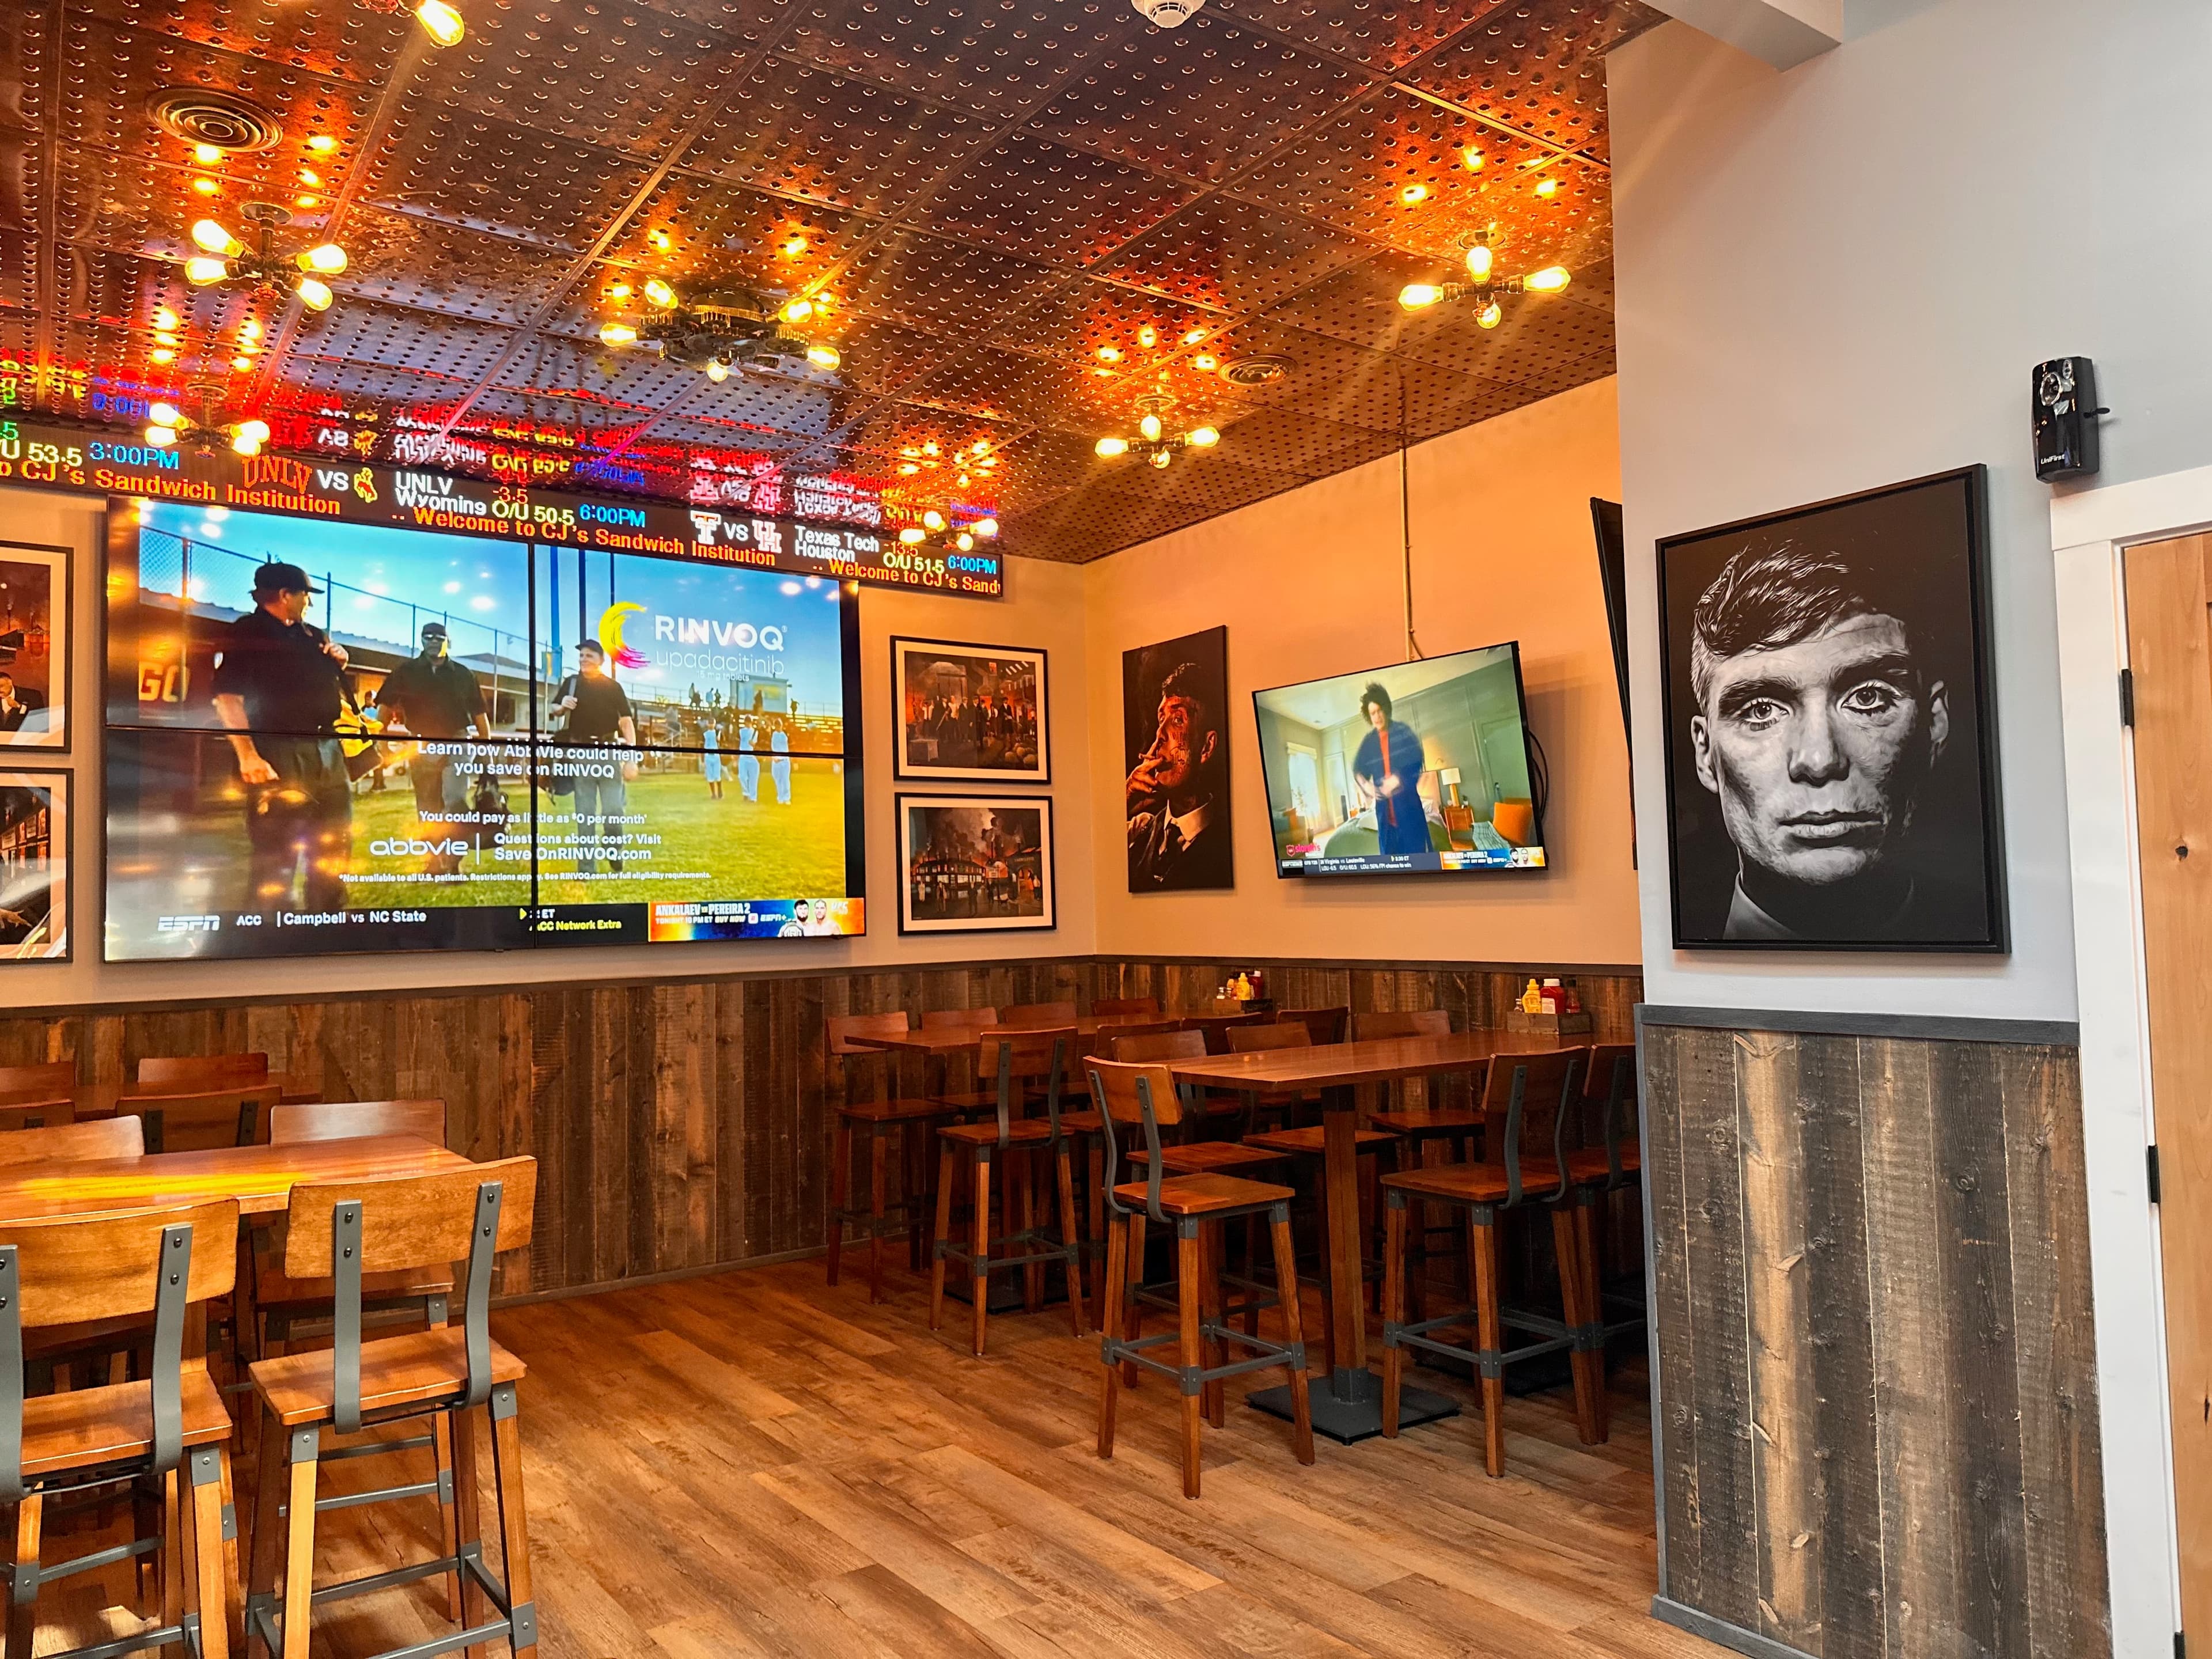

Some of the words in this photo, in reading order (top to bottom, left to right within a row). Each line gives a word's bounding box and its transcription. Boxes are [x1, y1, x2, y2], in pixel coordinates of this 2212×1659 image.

[29, 442, 82, 467] 53.5
[89, 441, 179, 469] 3:00PM
[241, 454, 313, 494] UNLV
[396, 471, 453, 495] UNLV
[95, 468, 216, 500] Sandwich
[226, 483, 340, 514] Institution
[395, 487, 487, 516] Wyoming
[493, 486, 528, 505] -3.5
[492, 499, 529, 520] O/U
[534, 505, 575, 527] 50.5
[579, 503, 646, 528] 6:00PM
[413, 506, 509, 533] Welcome
[514, 520, 535, 537] to
[596, 528, 684, 555] Sandwich
[692, 540, 775, 566] Institution
[794, 525, 841, 547] Texas
[844, 532, 880, 552] Tech
[794, 540, 855, 562] Houston
[883, 540, 918, 557] -13.5
[828, 559, 899, 582] Welcome
[904, 571, 919, 584] to
[883, 551, 911, 570] O/U
[914, 556, 945, 574] 51.5
[948, 555, 997, 575] 6:00PM
[656, 649, 784, 675] upadacitinib
[707, 672, 721, 681] mg
[723, 672, 750, 681] tablets
[417, 734, 463, 755] Learn
[467, 736, 500, 757] how
[567, 740, 609, 760] could
[613, 741, 644, 763] help
[454, 762, 483, 777] you
[487, 763, 522, 775] save
[553, 763, 615, 779] RINVOQ
[419, 810, 443, 823] You
[445, 810, 480, 823] could
[483, 813, 505, 825] pay
[507, 813, 521, 823] as
[556, 815, 569, 823] as
[587, 814, 605, 825] per
[370, 836, 469, 856] abbvie
[493, 832, 562, 845] Questions
[565, 833, 599, 844] about
[602, 834, 633, 844] cost?
[635, 834, 662, 844] Visit
[359, 873, 396, 882] available
[397, 873, 406, 882] to
[407, 873, 417, 882] all
[470, 872, 516, 881] Restrictions
[608, 871, 619, 880] for
[619, 871, 631, 880] full
[236, 914, 262, 926] ACC
[283, 912, 346, 927] Campbell
[351, 914, 365, 923] vs
[370, 910, 389, 923] NC
[392, 910, 427, 923] State
[656, 904, 701, 916] ANKALAEV
[708, 903, 744, 915] PEREIRA
[744, 903, 751, 914] 2
[158, 915, 221, 931] ESPN
[555, 919, 596, 931] Network
[597, 919, 622, 930] Extra
